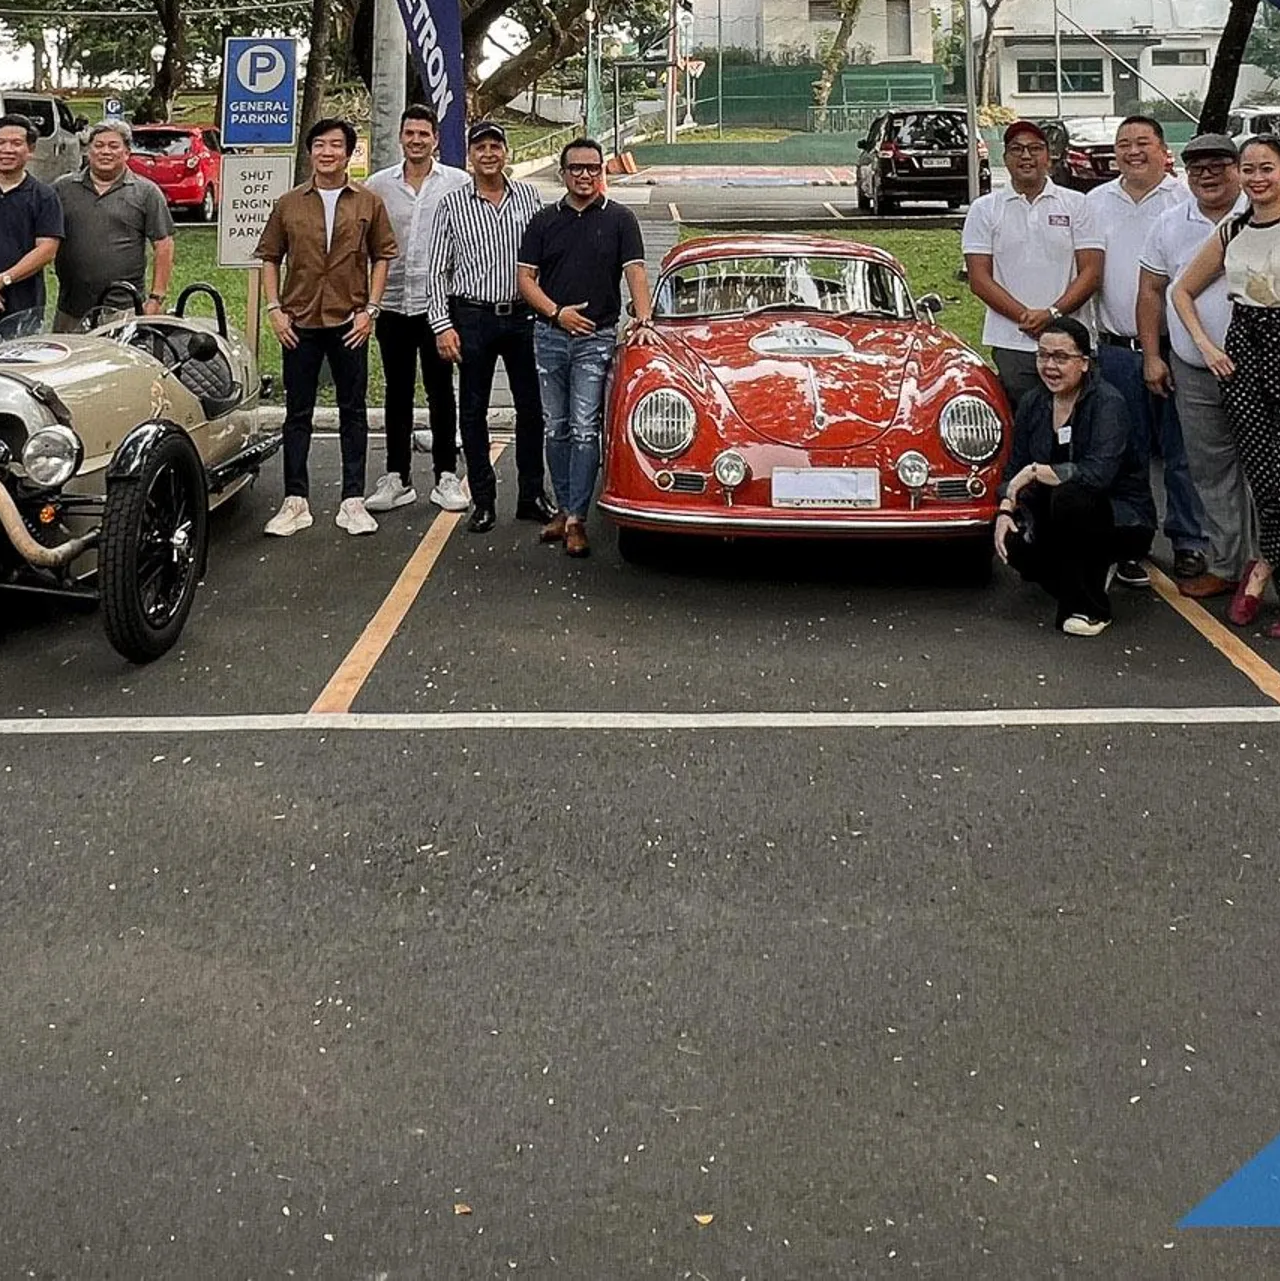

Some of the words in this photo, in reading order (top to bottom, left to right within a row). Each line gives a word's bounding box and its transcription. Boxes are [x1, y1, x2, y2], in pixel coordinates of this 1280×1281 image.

[249, 52, 277, 87] P
[229, 101, 290, 112] GENERAL
[230, 113, 288, 124] PARKING
[240, 170, 274, 181] SHUT
[243, 184, 269, 195] OFF
[235, 213, 269, 223] WHIL
[228, 227, 263, 238] PARK
